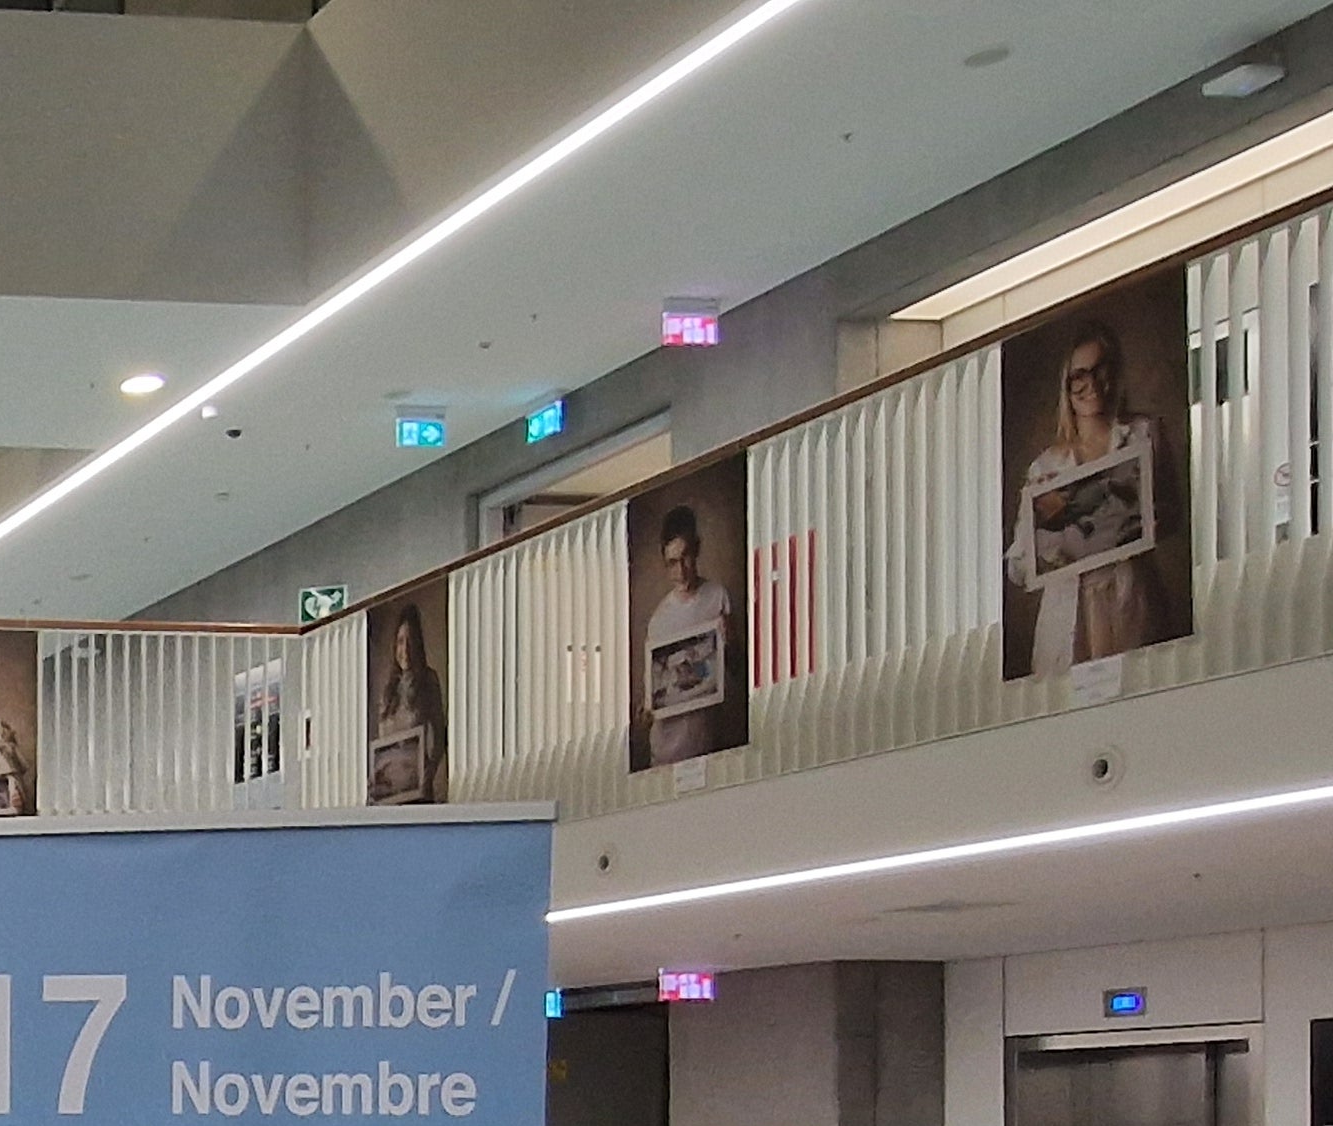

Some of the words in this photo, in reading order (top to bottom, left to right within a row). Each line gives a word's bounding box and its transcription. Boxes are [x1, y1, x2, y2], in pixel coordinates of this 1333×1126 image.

[171, 971, 476, 1030] November
[491, 969, 516, 1025] /
[171, 1061, 476, 1116] Novembre
